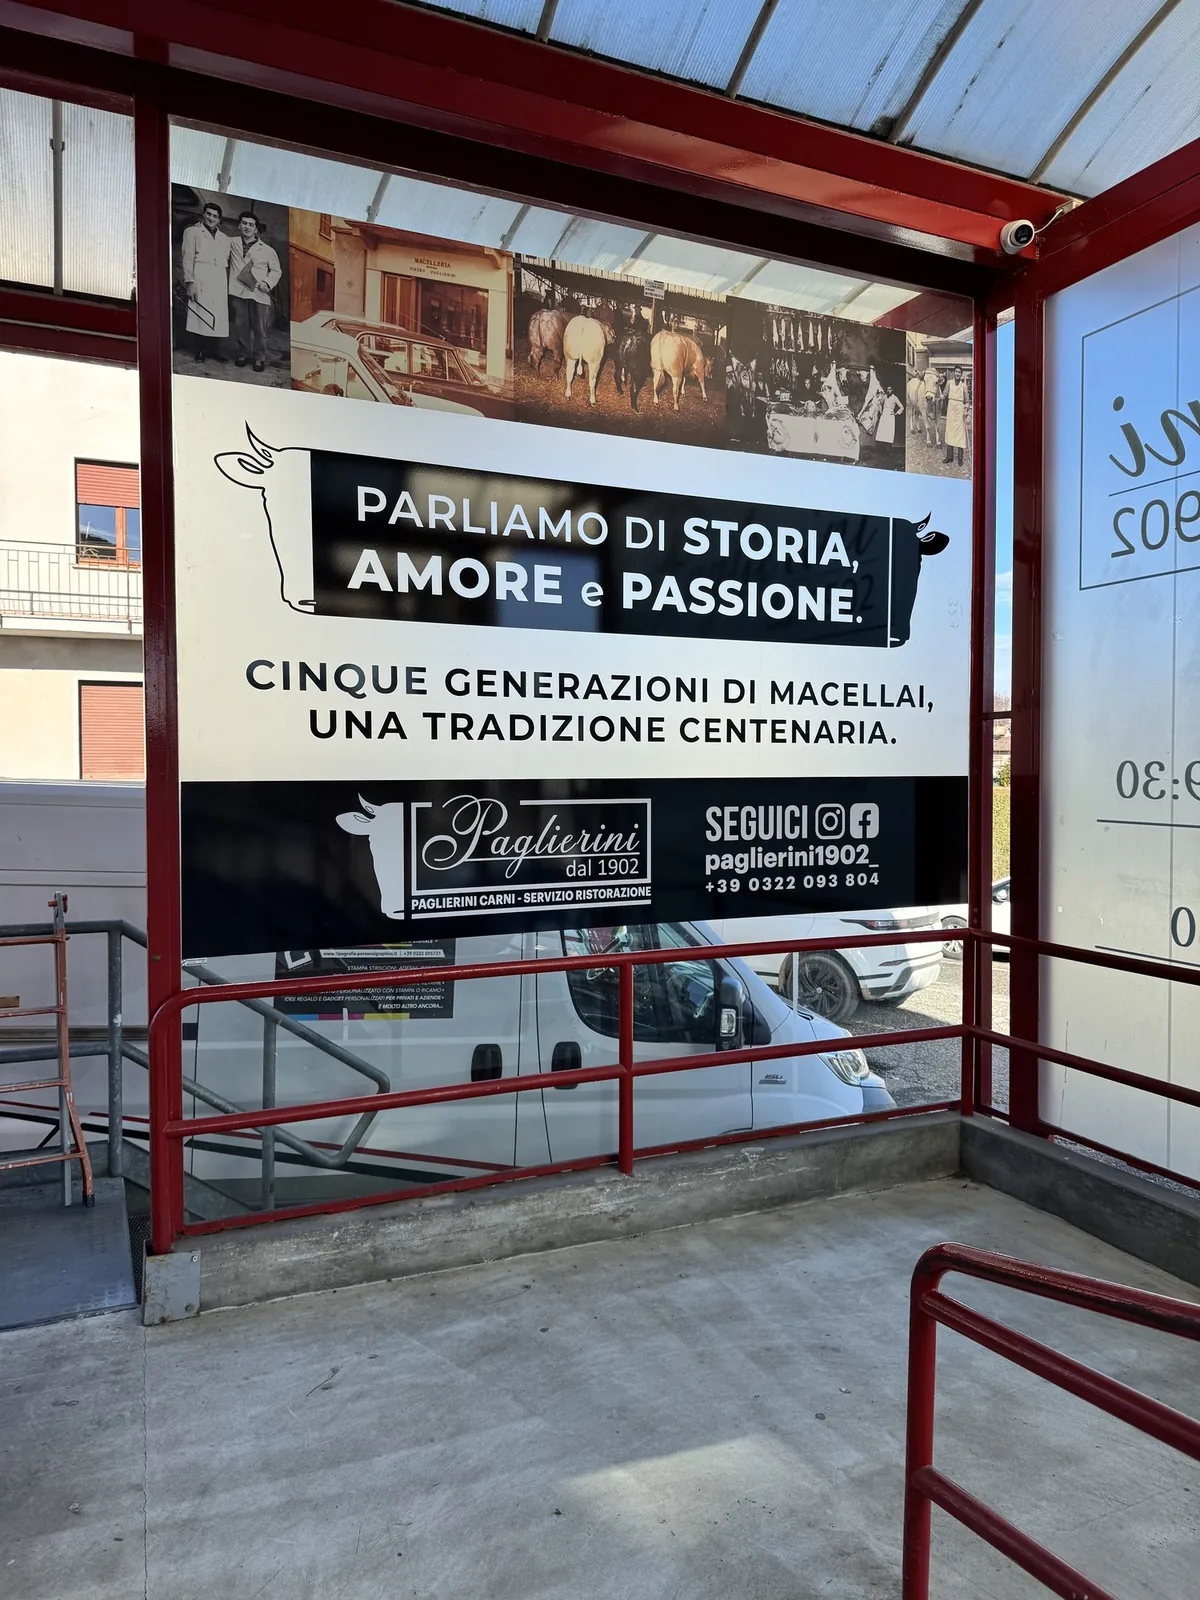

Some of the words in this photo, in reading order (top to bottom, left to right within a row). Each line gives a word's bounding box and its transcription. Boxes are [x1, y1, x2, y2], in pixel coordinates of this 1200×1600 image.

[357, 485, 608, 546] PARLIAMO
[625, 516, 665, 552] DI
[683, 517, 859, 574] STORIA,
[347, 548, 563, 605] AMORE
[580, 581, 605, 607] e
[622, 571, 864, 624] PASSIONE.
[245, 659, 428, 700] CINQUE
[444, 668, 708, 703] GENERAZIONI
[723, 678, 756, 704] DI
[770, 680, 934, 713] MACELLAI,
[309, 709, 408, 740] UNA
[422, 712, 666, 743] TRADIZIONE
[679, 717, 897, 745] CENTENARIA.
[421, 794, 641, 879] Paglierini
[705, 804, 808, 842] SEGUICI
[565, 859, 592, 877] dal
[598, 857, 639, 876] 1902
[705, 843, 880, 876] paglierini1902_
[411, 895, 478, 911] PAGLIERINI
[479, 893, 516, 906] CARNI
[523, 890, 574, 904] SERVIZIO
[575, 886, 652, 901] RISTORAZIONE
[705, 878, 741, 893] +39
[748, 876, 796, 892] 0322
[803, 874, 838, 889] 093
[845, 872, 880, 887] 804
